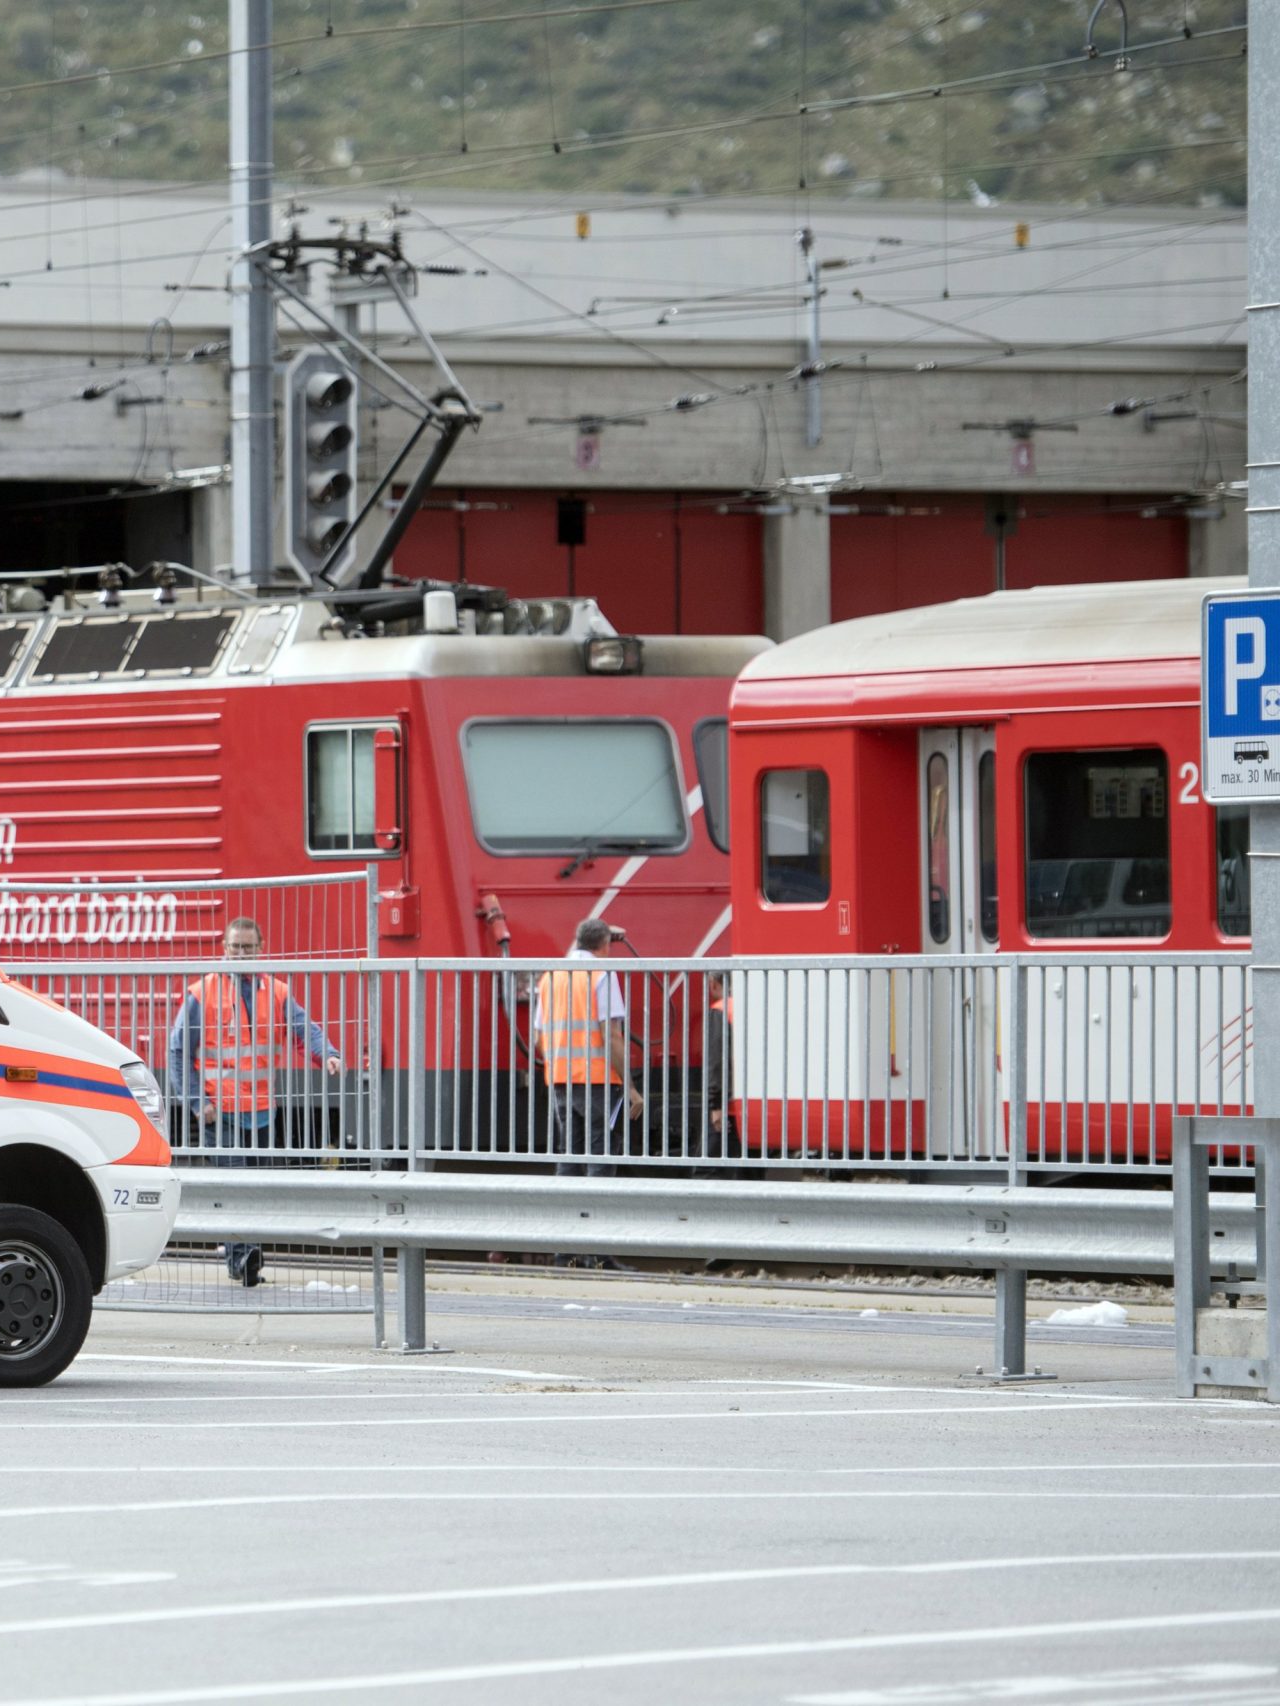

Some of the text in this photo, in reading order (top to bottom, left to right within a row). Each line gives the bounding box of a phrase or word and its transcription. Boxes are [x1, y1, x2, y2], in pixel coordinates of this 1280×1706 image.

[1224, 616, 1267, 716] P
[1179, 761, 1200, 804] 2
[1221, 773, 1243, 784] max.
[1248, 769, 1259, 783] 30
[113, 1188, 130, 1206] 72
